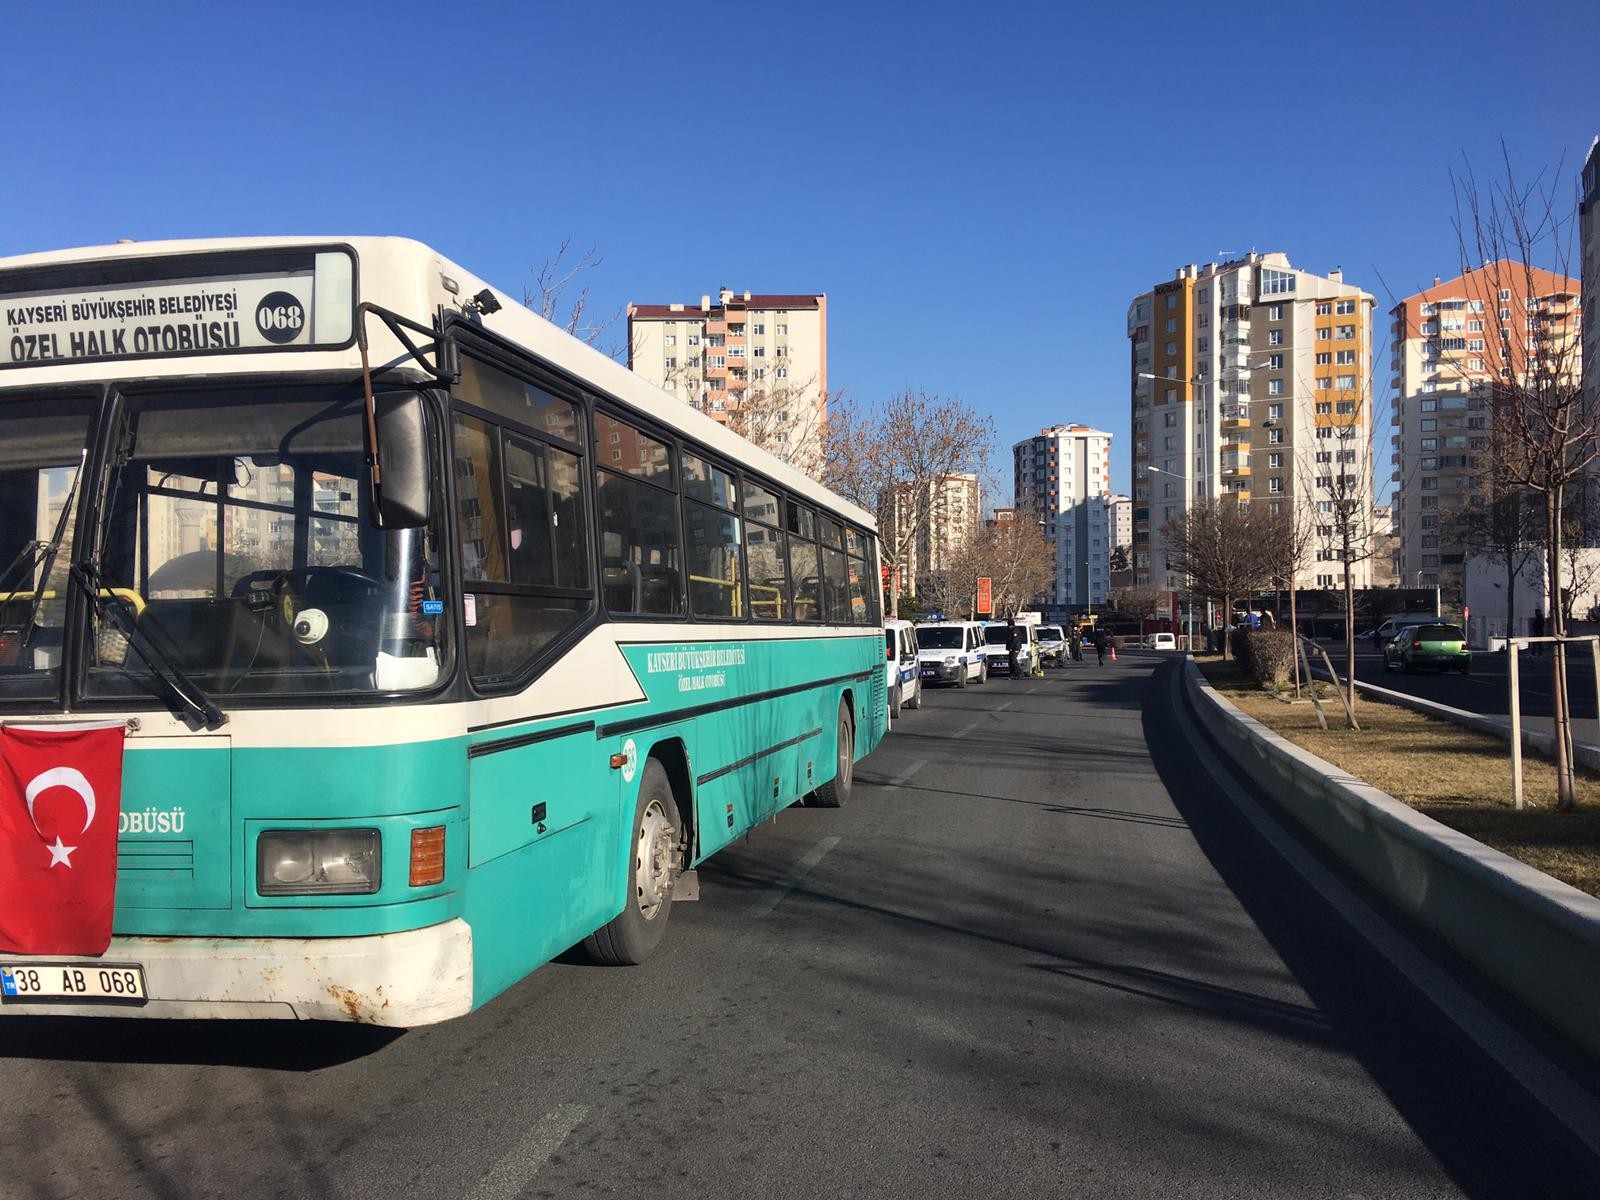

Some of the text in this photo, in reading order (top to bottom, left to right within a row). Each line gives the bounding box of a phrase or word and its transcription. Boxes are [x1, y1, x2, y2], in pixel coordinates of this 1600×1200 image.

[7, 288, 239, 326] KAYSERİ BÜYÜKŞEHİR BELEDİYESİ
[259, 306, 302, 330] 068
[10, 313, 240, 362] ÖZEL HALK OTOBÜSÜ
[5, 982, 16, 990] TR
[15, 969, 138, 995] 38 AB 068
